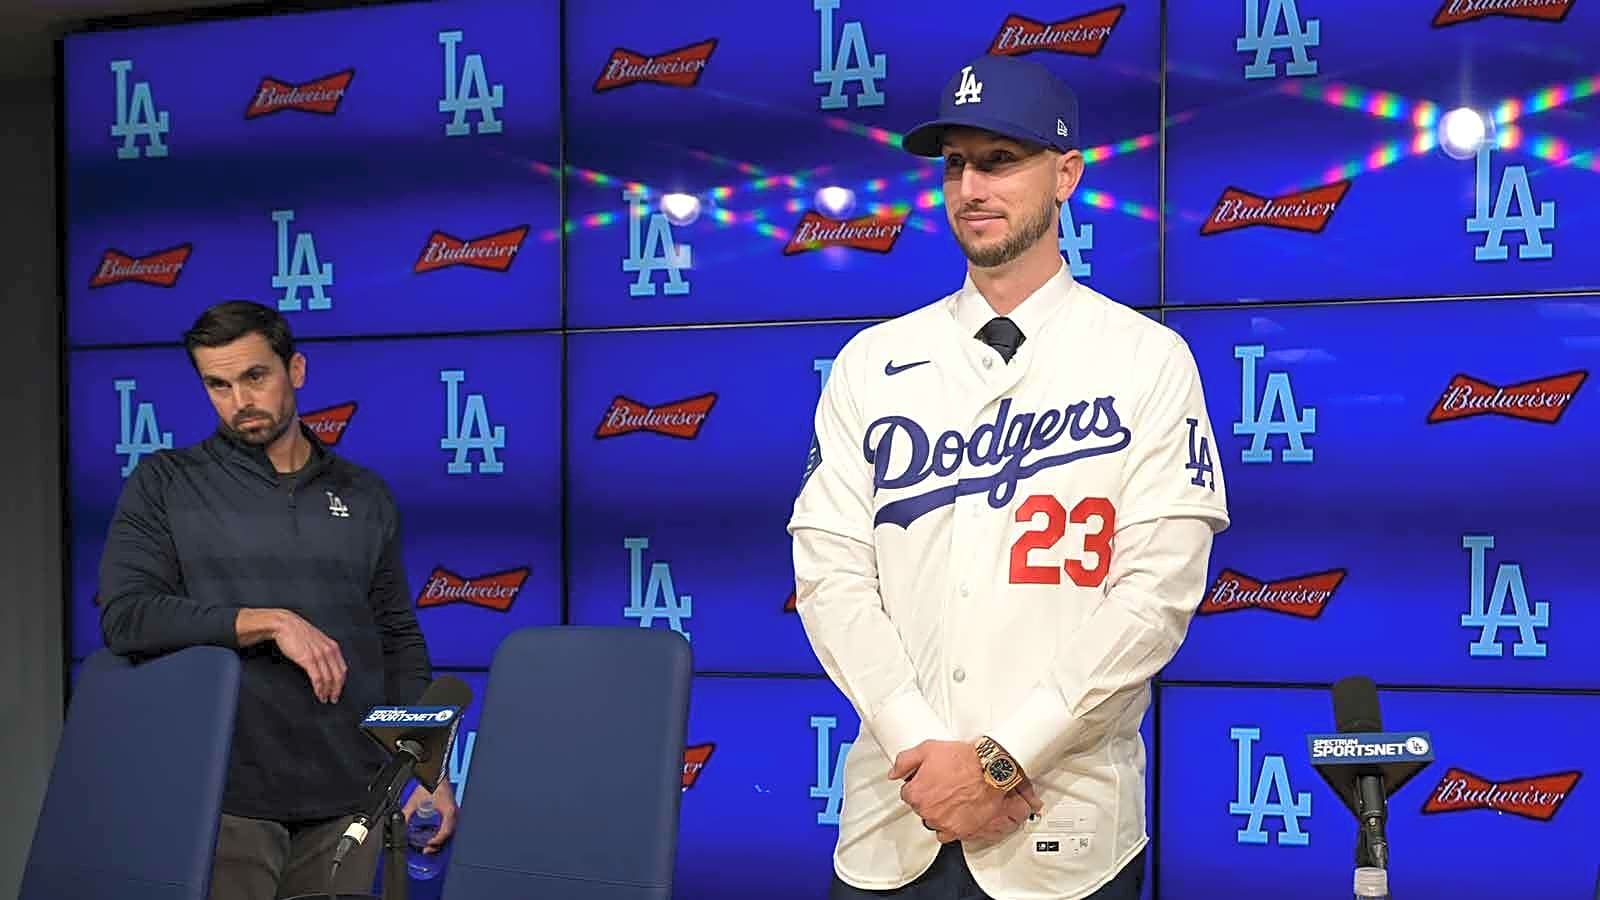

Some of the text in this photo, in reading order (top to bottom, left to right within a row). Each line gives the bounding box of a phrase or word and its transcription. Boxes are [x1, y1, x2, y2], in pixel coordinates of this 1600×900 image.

[812, 0, 887, 109] LA
[998, 24, 1112, 49] Budweiser
[1237, 0, 1320, 78] LA
[254, 83, 346, 107] Budweiser
[438, 31, 504, 135] LA
[604, 56, 706, 81] Budweiser
[955, 66, 983, 105] LA
[111, 60, 169, 159] LA
[1214, 199, 1335, 224] Budweiser
[1466, 140, 1555, 261] LA
[423, 238, 522, 263] Budweiser
[623, 190, 692, 296] LA
[795, 219, 903, 243] Budweiser
[98, 257, 184, 279] Budweiser
[271, 210, 333, 311] LA
[440, 370, 506, 474] LA
[605, 404, 706, 428] Budweiser
[1233, 345, 1316, 463] LA
[1443, 384, 1570, 411] Budweiser
[114, 379, 173, 478] LA
[863, 395, 1131, 518] Dodgers
[1185, 418, 1215, 492] LA
[325, 491, 350, 517] LA
[1009, 494, 1116, 588] 23
[424, 575, 520, 600] Budweiser
[624, 537, 692, 642] LA
[1211, 578, 1331, 605] Budweiser
[1461, 535, 1550, 657] LA
[1313, 738, 1358, 746] SPECTRUM
[1313, 743, 1405, 758] SPORTSNET
[1229, 727, 1312, 845] LA
[1437, 776, 1565, 806] Budweiser
